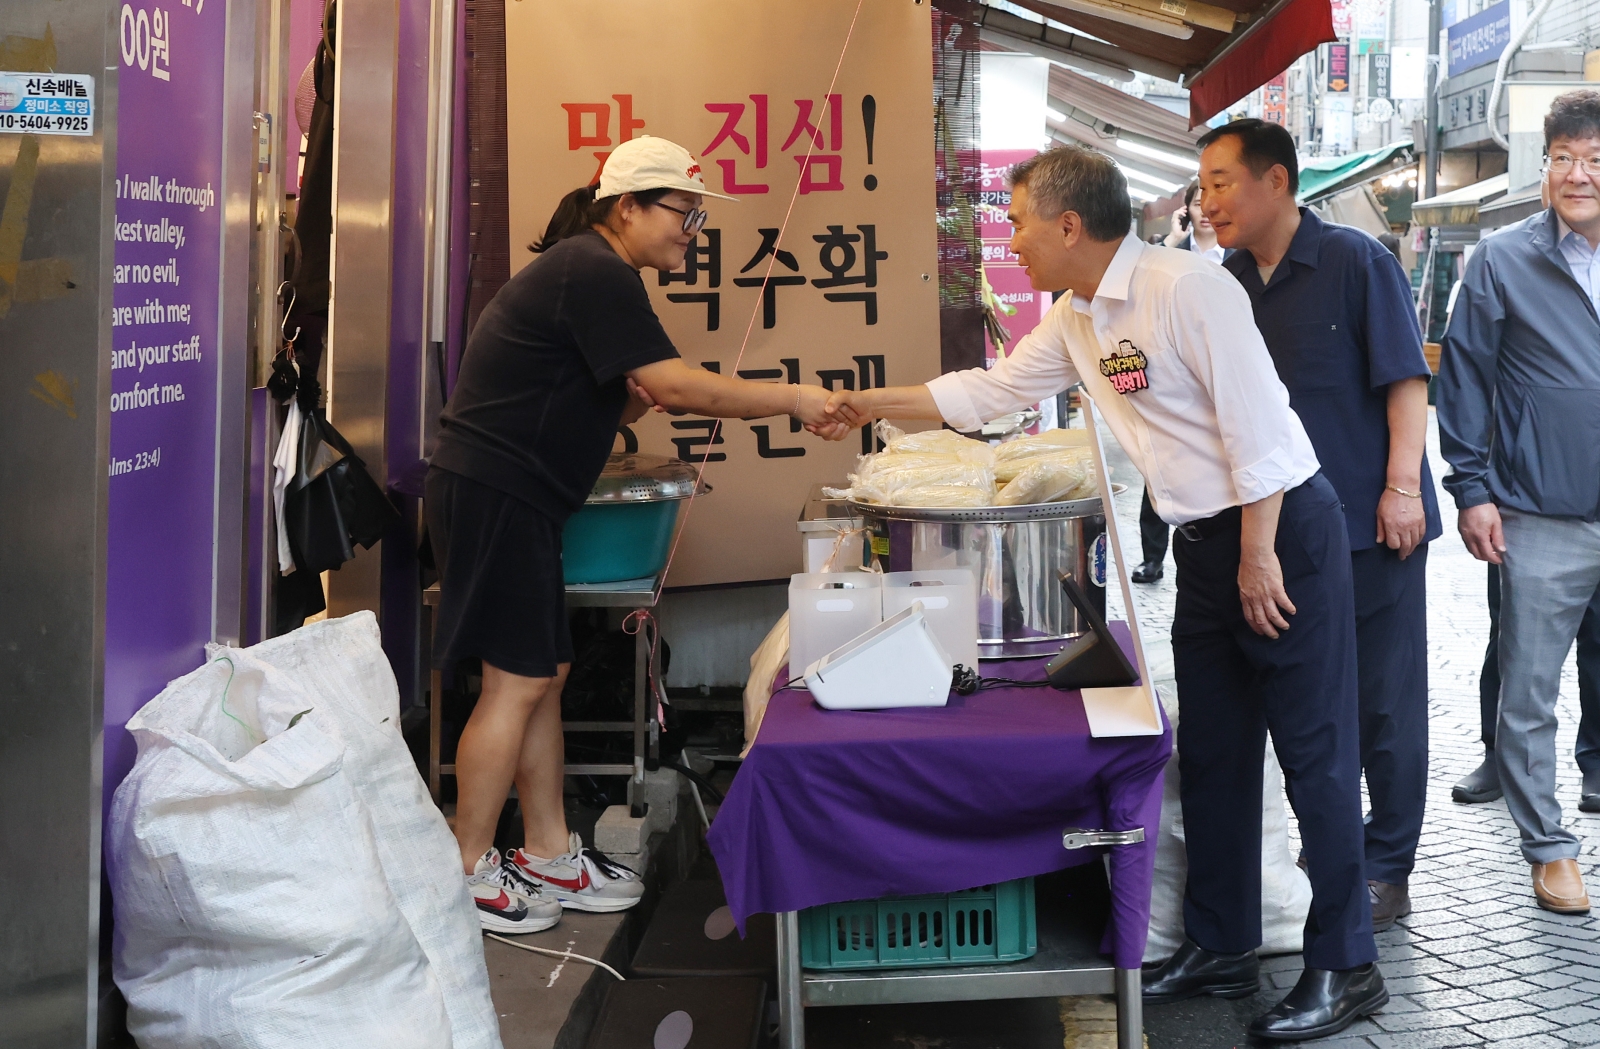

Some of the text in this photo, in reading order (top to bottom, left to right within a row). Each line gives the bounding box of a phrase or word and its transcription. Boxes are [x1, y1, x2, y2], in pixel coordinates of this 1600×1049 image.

[25, 99, 88, 114] 정미소 직영
[0, 114, 88, 131] 10-5404-9925
[701, 94, 878, 195] 진심!
[123, 174, 129, 199] I
[131, 175, 163, 202] walk
[165, 178, 215, 212] through
[144, 217, 186, 250] valley,
[132, 264, 151, 283] no
[153, 258, 180, 286] evil,
[133, 298, 165, 325] with
[167, 304, 191, 325] me;
[111, 335, 202, 373] and your staff,
[161, 384, 186, 404] me.
[1109, 369, 1147, 393] 김현기
[134, 447, 161, 471] 23:4)
